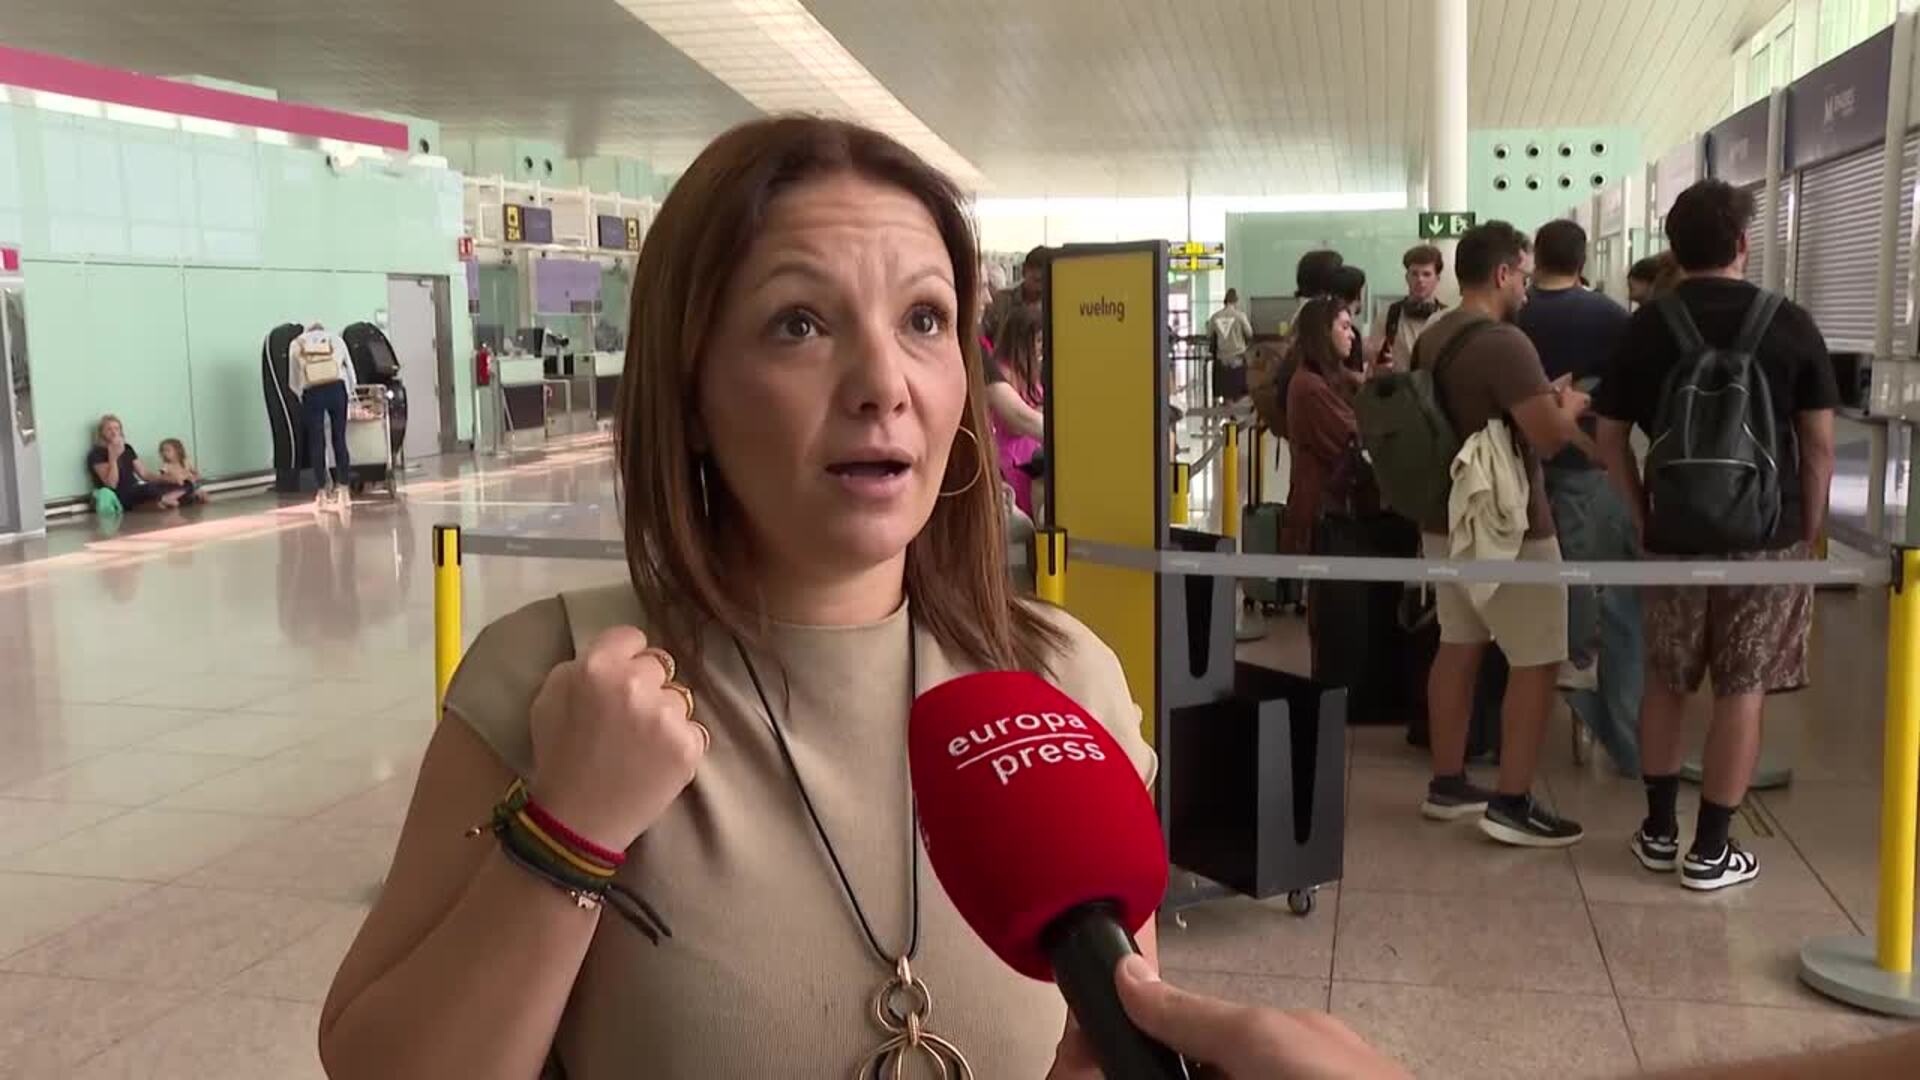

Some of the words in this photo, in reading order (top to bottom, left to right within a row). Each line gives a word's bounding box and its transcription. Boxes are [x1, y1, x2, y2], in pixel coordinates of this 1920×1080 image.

[1080, 295, 1125, 323] vueling
[947, 712, 1088, 757] europa
[991, 740, 1106, 785] press
